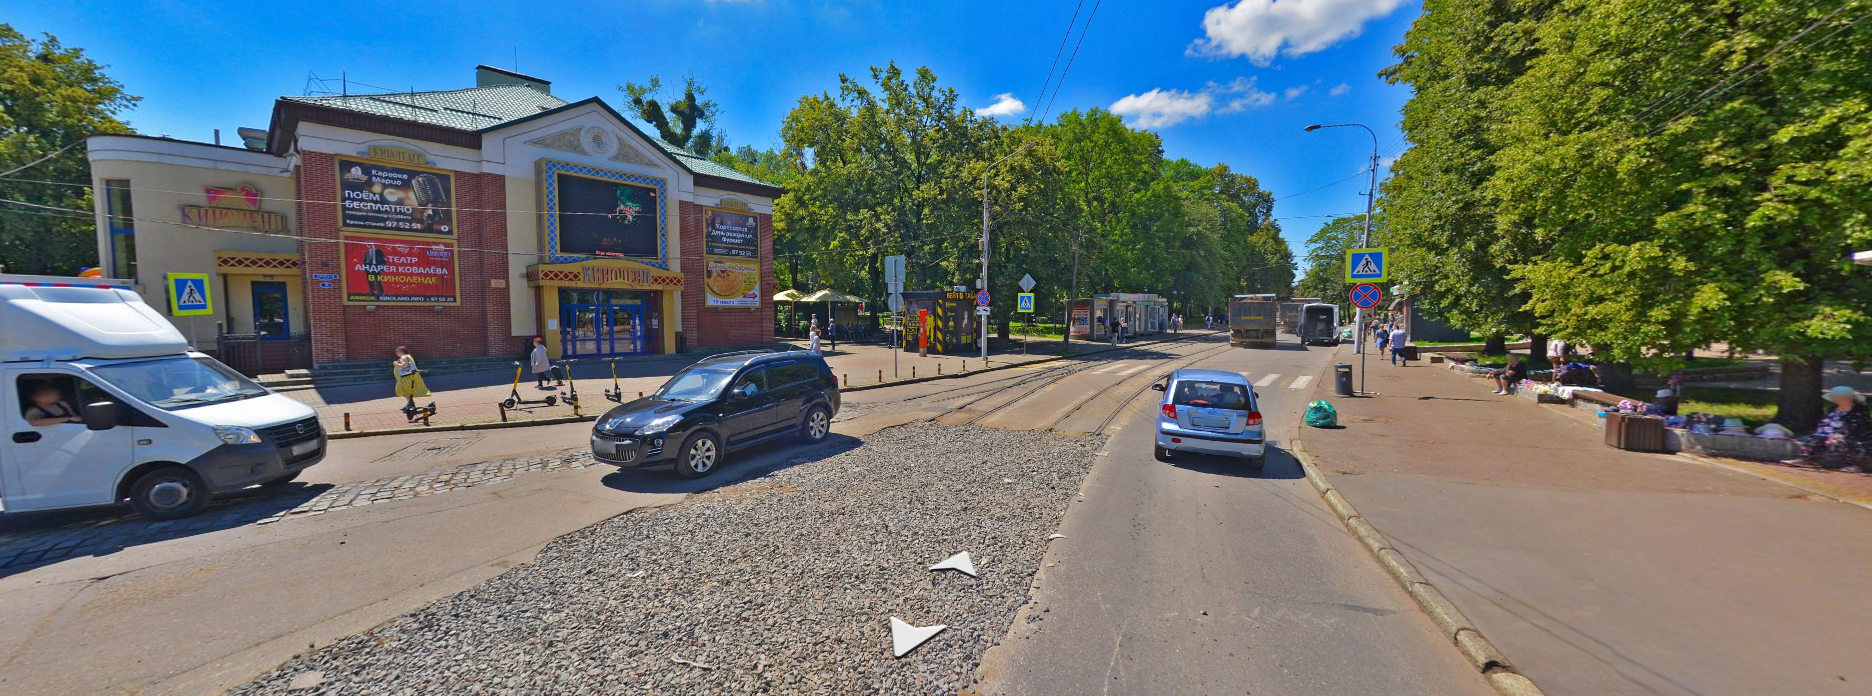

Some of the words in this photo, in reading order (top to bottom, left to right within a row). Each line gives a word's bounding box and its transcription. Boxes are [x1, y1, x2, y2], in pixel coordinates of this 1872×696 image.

[372, 169, 408, 180] Караоке
[372, 176, 402, 186] Марио
[345, 190, 380, 201] ПОЁМ
[346, 200, 412, 213] БЕСПЛАТНО
[355, 264, 396, 273] АНДРЕЯ
[398, 266, 448, 274] КОВАЛЁВА
[377, 275, 438, 284] КИНОЛЕНДЕ
[582, 266, 651, 287] КИНОЛЕНД
